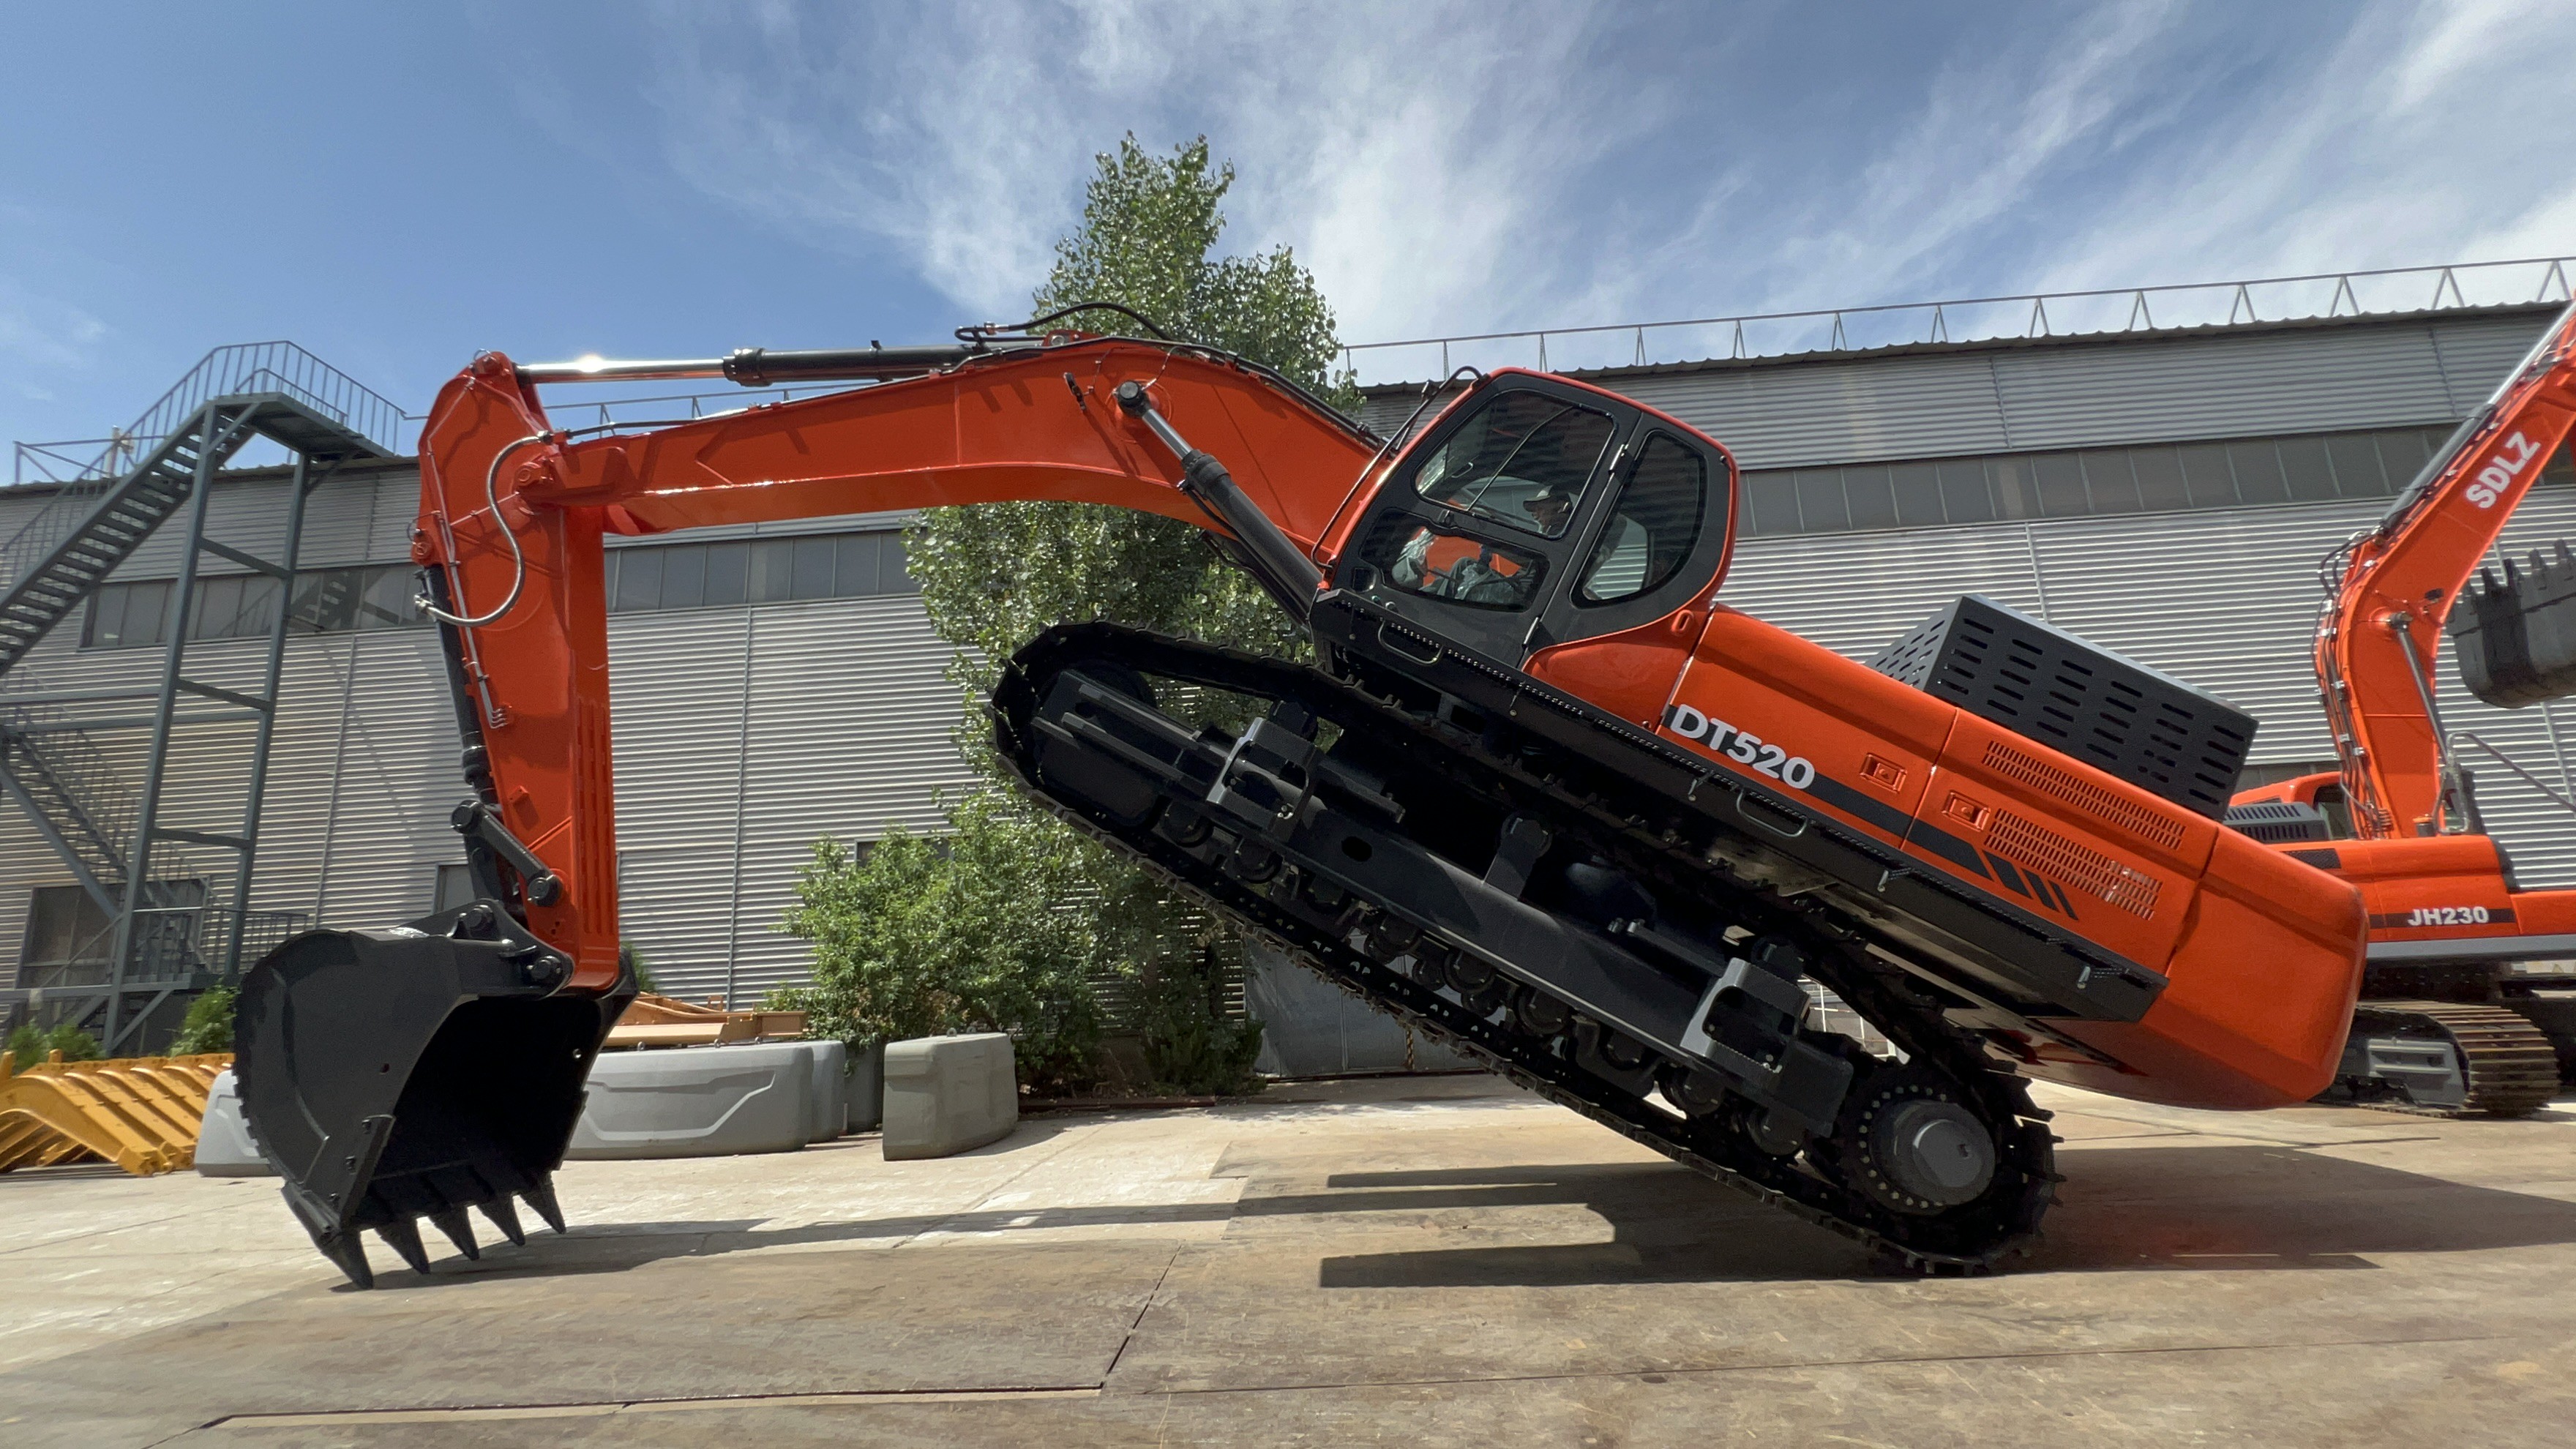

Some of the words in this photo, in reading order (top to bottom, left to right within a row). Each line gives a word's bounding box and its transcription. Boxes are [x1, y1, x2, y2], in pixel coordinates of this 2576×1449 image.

[2465, 431, 2541, 509] SDLZ
[1670, 703, 1815, 790] DT520
[2407, 906, 2490, 927] JH230
